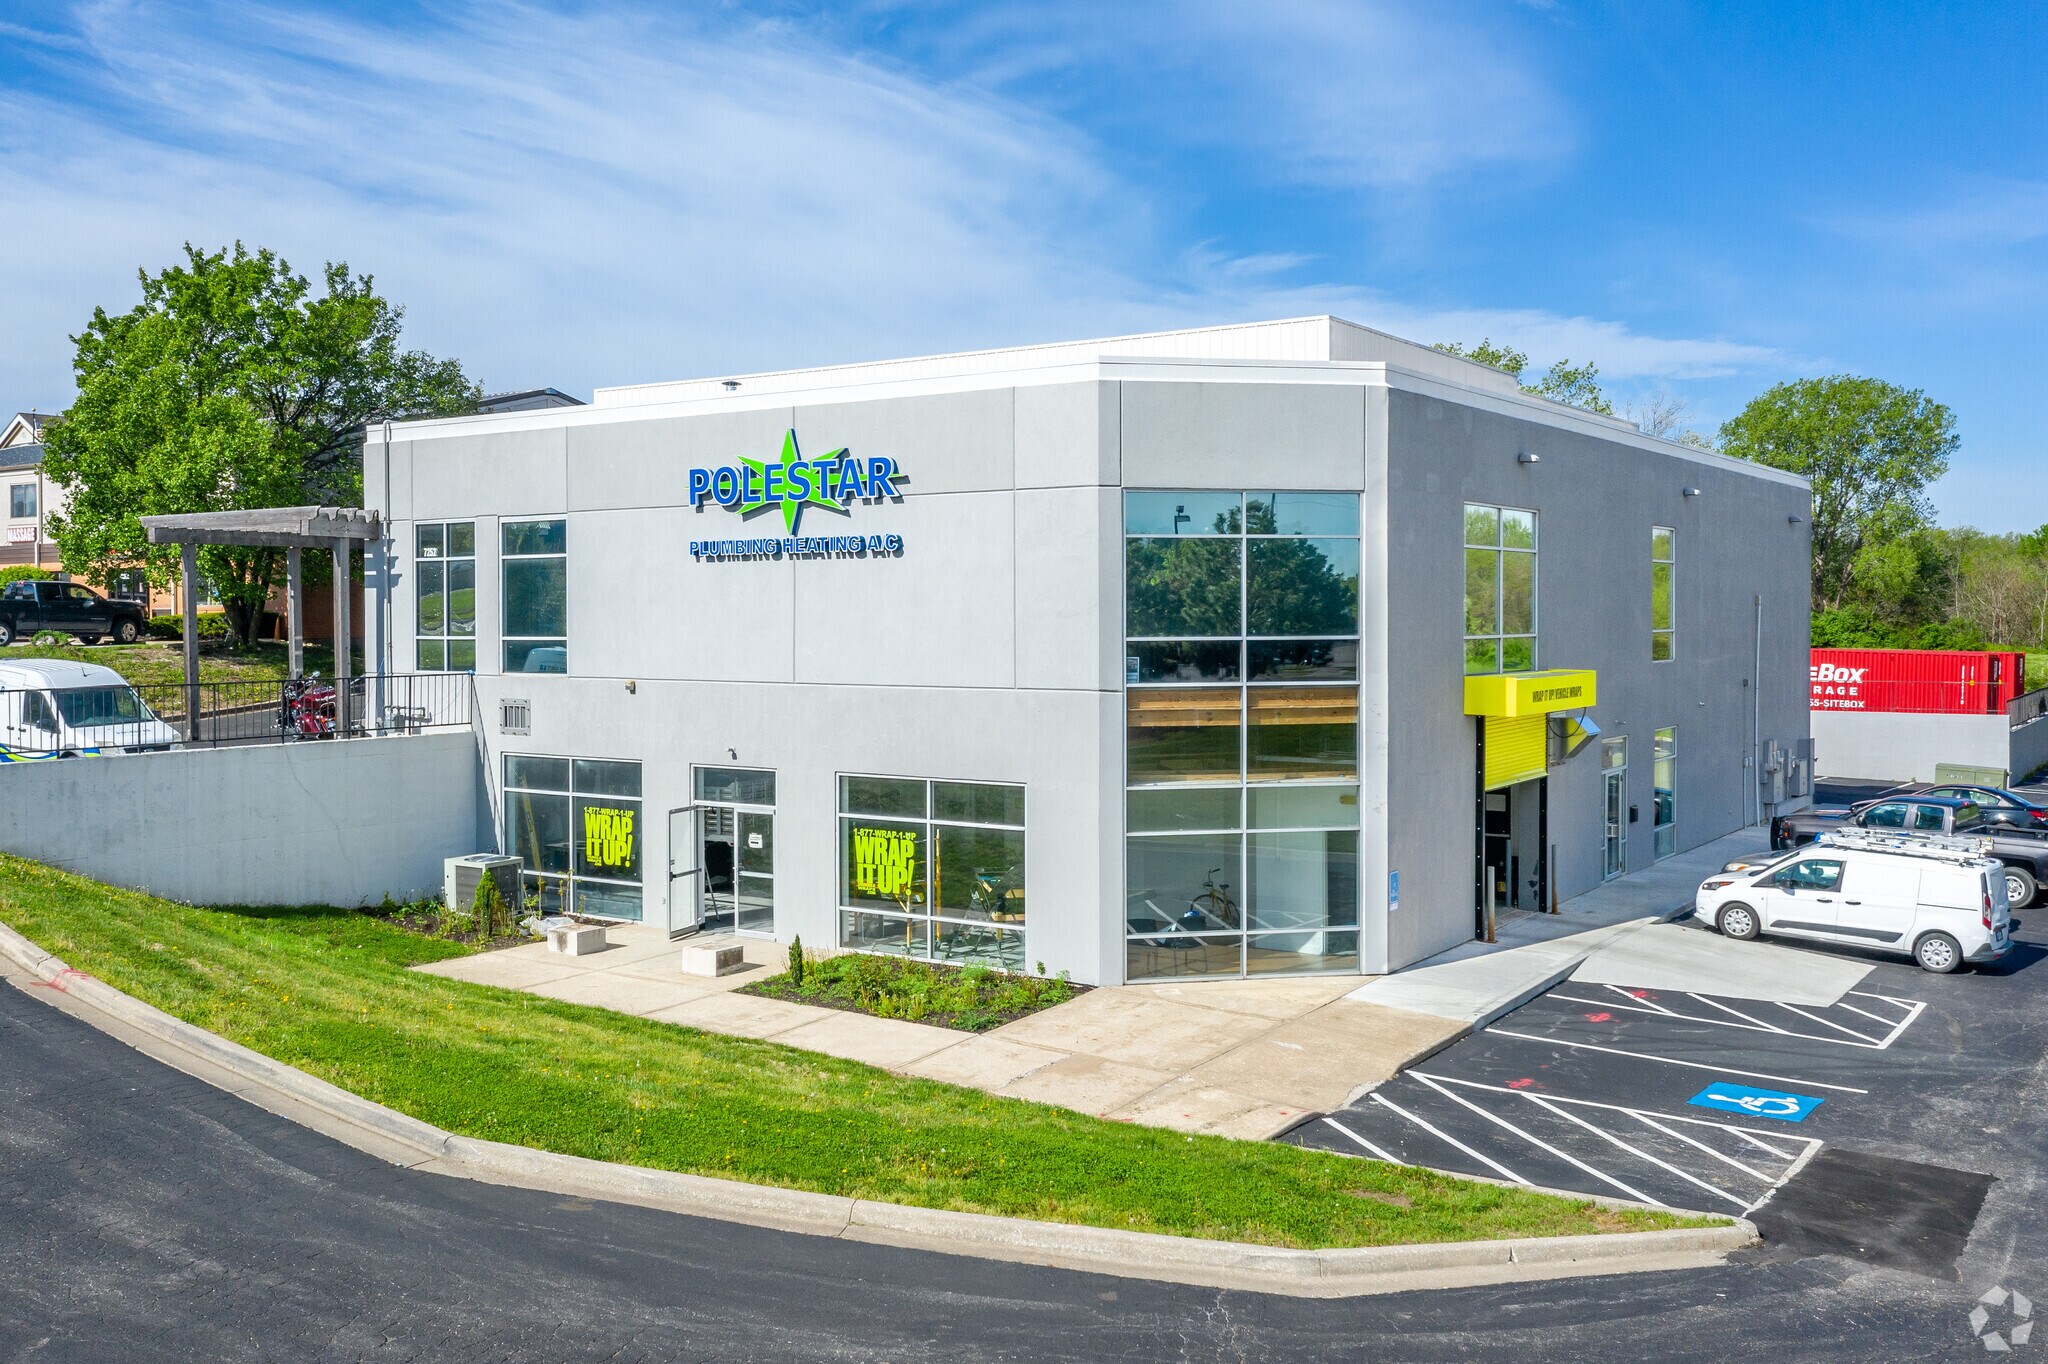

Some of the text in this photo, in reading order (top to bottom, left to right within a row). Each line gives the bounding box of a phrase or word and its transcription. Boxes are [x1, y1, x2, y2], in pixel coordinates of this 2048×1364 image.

[689, 456, 898, 506] POLESTAR
[7, 527, 35, 542] MASSAGE
[689, 538, 777, 556] PLUMBING
[782, 535, 862, 553] HEATING
[1532, 691, 1543, 703] WRAP
[1813, 685, 1858, 696] RAGE
[584, 813, 633, 842] WRAP
[853, 828, 917, 841] 1-877-WRAP-1-UP
[586, 837, 603, 856] IT
[854, 836, 915, 867] WRAP
[857, 863, 877, 886] IT
